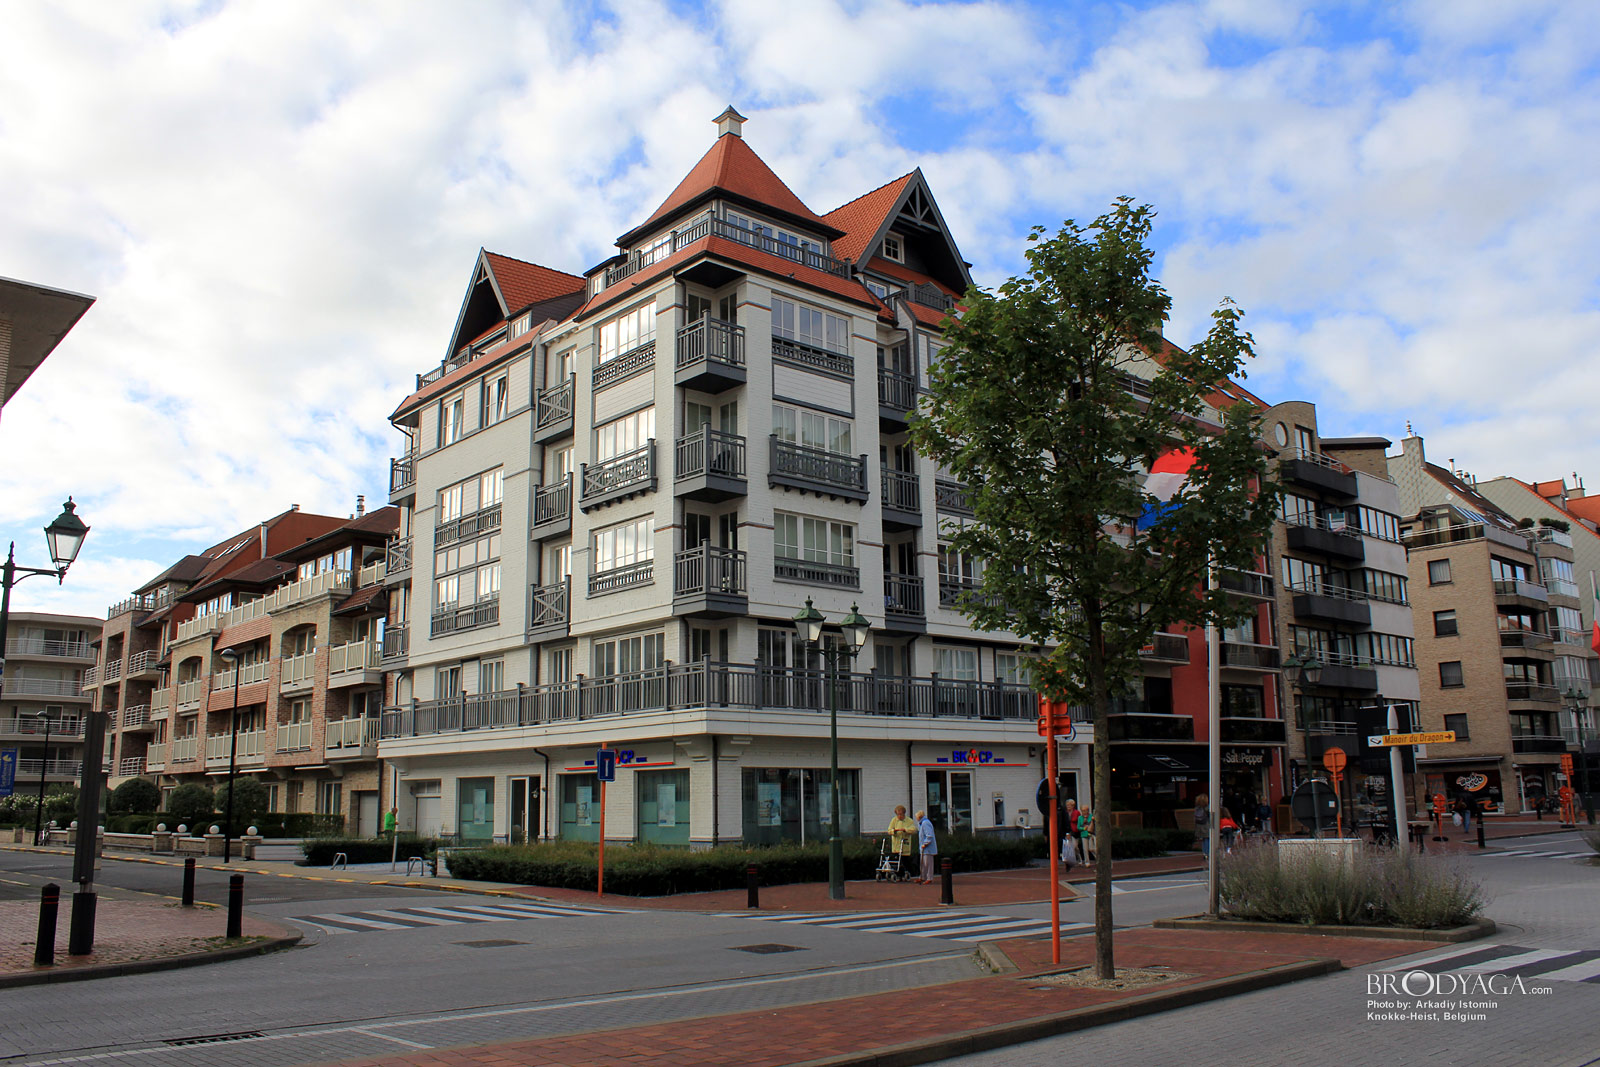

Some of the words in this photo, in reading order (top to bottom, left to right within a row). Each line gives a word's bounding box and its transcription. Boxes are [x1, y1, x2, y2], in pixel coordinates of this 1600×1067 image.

[1385, 735, 1407, 744] Manoir
[1409, 735, 1418, 743] du
[1420, 733, 1444, 743] Dragon
[1241, 752, 1264, 766] Pepper
